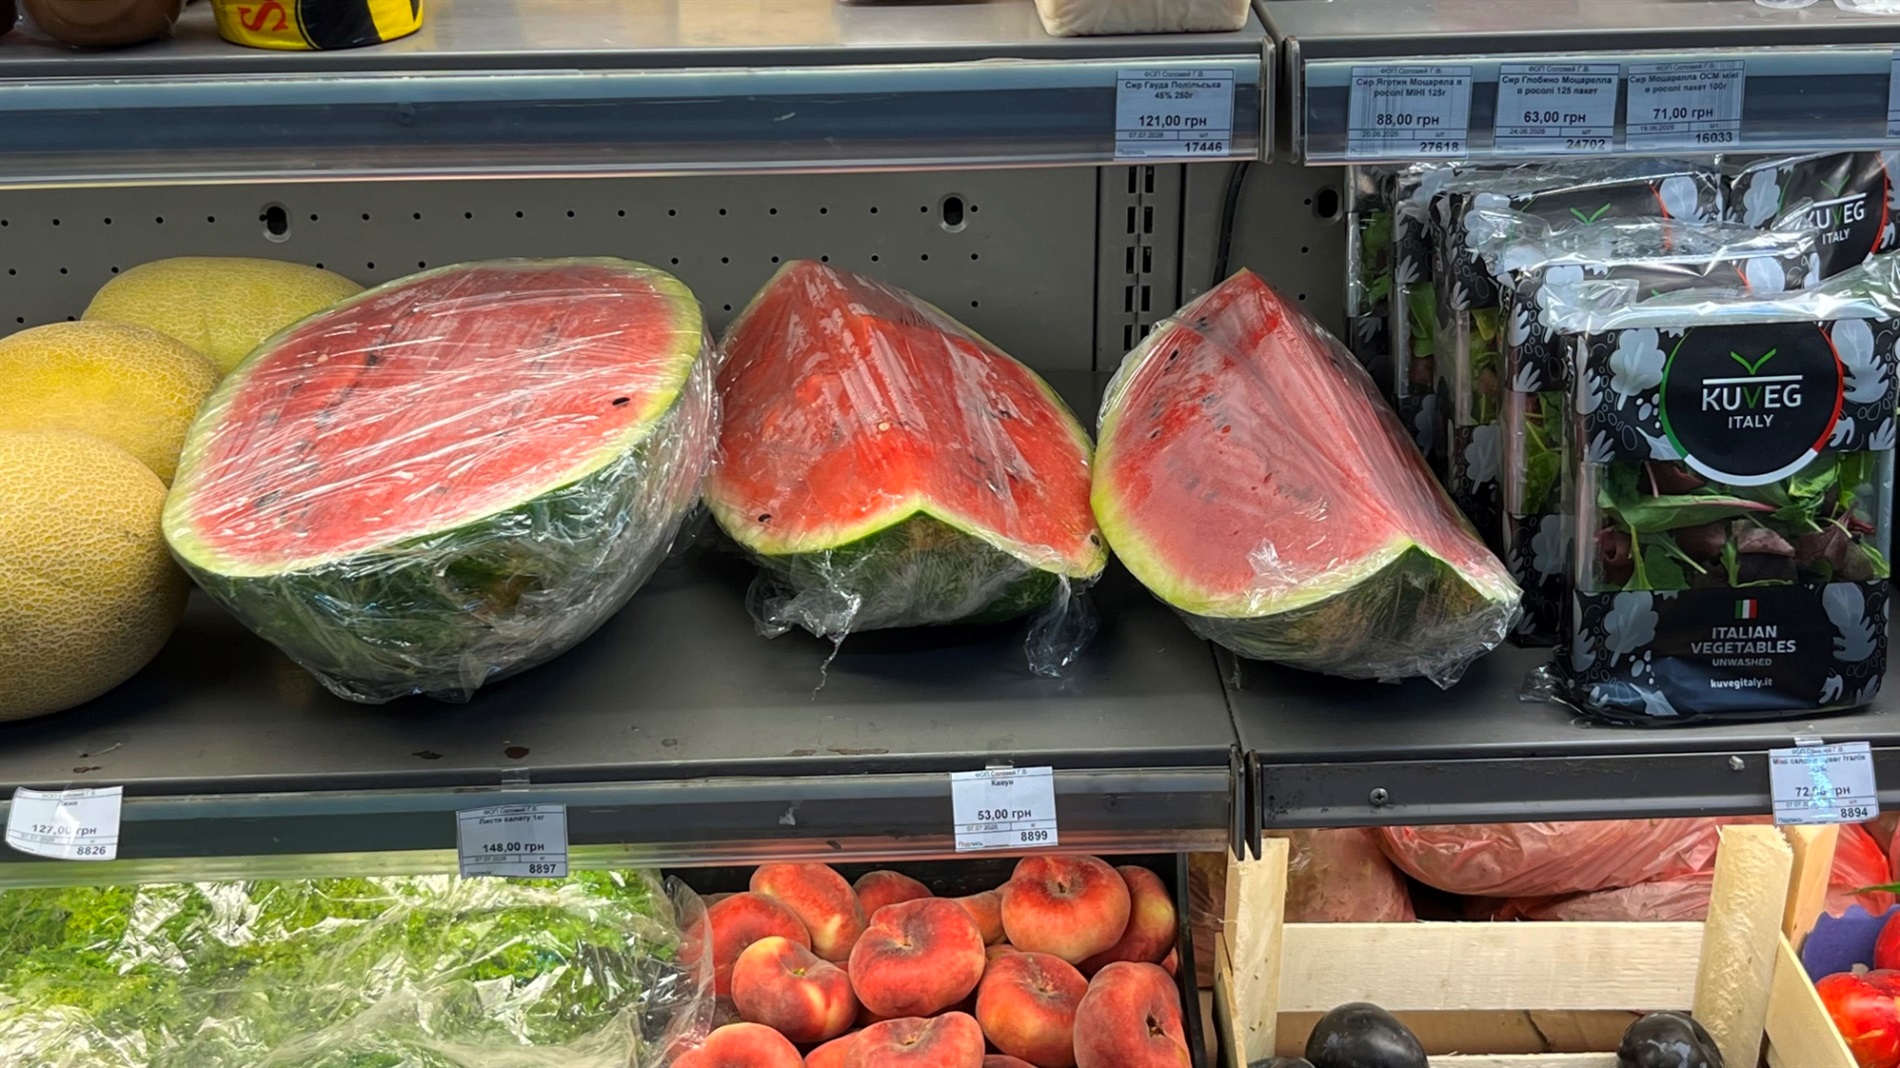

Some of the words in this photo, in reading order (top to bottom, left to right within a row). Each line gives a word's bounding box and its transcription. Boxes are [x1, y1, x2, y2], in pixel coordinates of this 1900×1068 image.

[236, 0, 289, 32] S
[1356, 78, 1374, 87] Сир
[1376, 78, 1407, 86] Яготин
[1409, 78, 1454, 87] Моцарела
[1502, 76, 1520, 85] Сир
[1521, 75, 1560, 84] Глобино
[1561, 76, 1613, 85] Моцарелла
[1629, 75, 1647, 84] Сир
[1648, 74, 1697, 83] Моцарелла
[1125, 81, 1142, 90] Сир
[1144, 81, 1169, 90] Гауда
[1652, 84, 1681, 94] росолі
[1154, 91, 1173, 100] 45%
[1174, 91, 1194, 100] 250г
[1373, 89, 1404, 98] росолі
[1428, 89, 1447, 97] 125г
[1524, 87, 1555, 96] росолі
[1557, 87, 1572, 95] 125
[1523, 111, 1560, 124] 63,00
[1563, 113, 1586, 125] грн
[1653, 107, 1688, 121] 71,00
[1691, 108, 1713, 120] грн
[1138, 115, 1181, 128] 121,00
[1184, 116, 1207, 129] грн
[1376, 113, 1413, 127] 88,00
[1416, 115, 1440, 127] грн
[1695, 132, 1733, 144] 16033
[1184, 142, 1223, 153] 17446
[1419, 142, 1459, 153] 27618
[1565, 139, 1606, 150] 24702
[1822, 228, 1850, 245] ITALY
[1701, 384, 1802, 412] KUVEG
[1728, 414, 1774, 429] ITALY
[1711, 625, 1778, 640] ITALIAN
[1690, 640, 1797, 654] VEGETABLES
[1712, 658, 1772, 667] UNWASHED
[1710, 677, 1774, 690] kuvegitaly.it
[991, 779, 1014, 787] Кавун
[977, 809, 1008, 821] 53,00
[1011, 809, 1032, 821] грн
[1840, 807, 1868, 819] 8894
[32, 824, 72, 836] 127,00
[76, 826, 97, 837] грн
[1020, 830, 1048, 842] 8899
[77, 845, 107, 856] 8826
[482, 842, 521, 853] 148,00
[524, 842, 545, 853] грн
[529, 864, 557, 874] 8897
